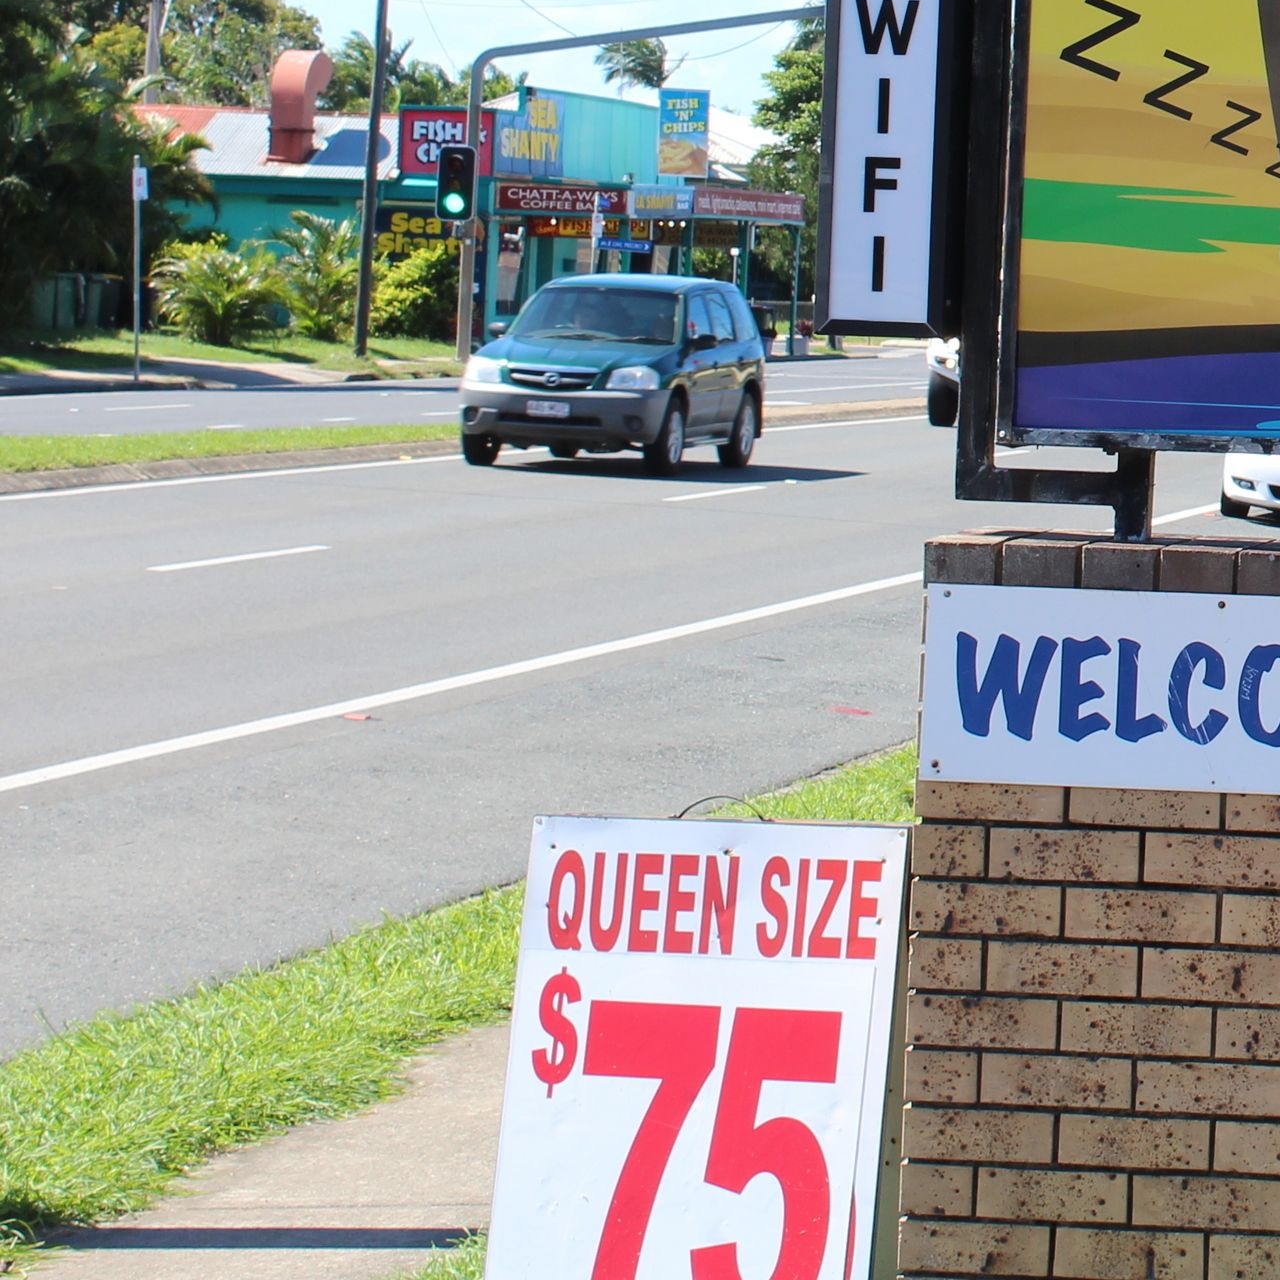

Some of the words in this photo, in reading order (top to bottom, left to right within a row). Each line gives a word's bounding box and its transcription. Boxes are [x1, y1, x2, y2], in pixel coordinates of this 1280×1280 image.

[528, 96, 557, 129] SEA
[667, 98, 699, 109] FISH
[413, 120, 463, 142] FISH
[663, 122, 705, 133] CHIPS
[501, 128, 559, 162] SHANTY
[520, 200, 572, 210] COFFEE
[391, 212, 442, 234] Sea
[547, 849, 740, 955] QUEEN
[756, 856, 884, 959] SIZE
